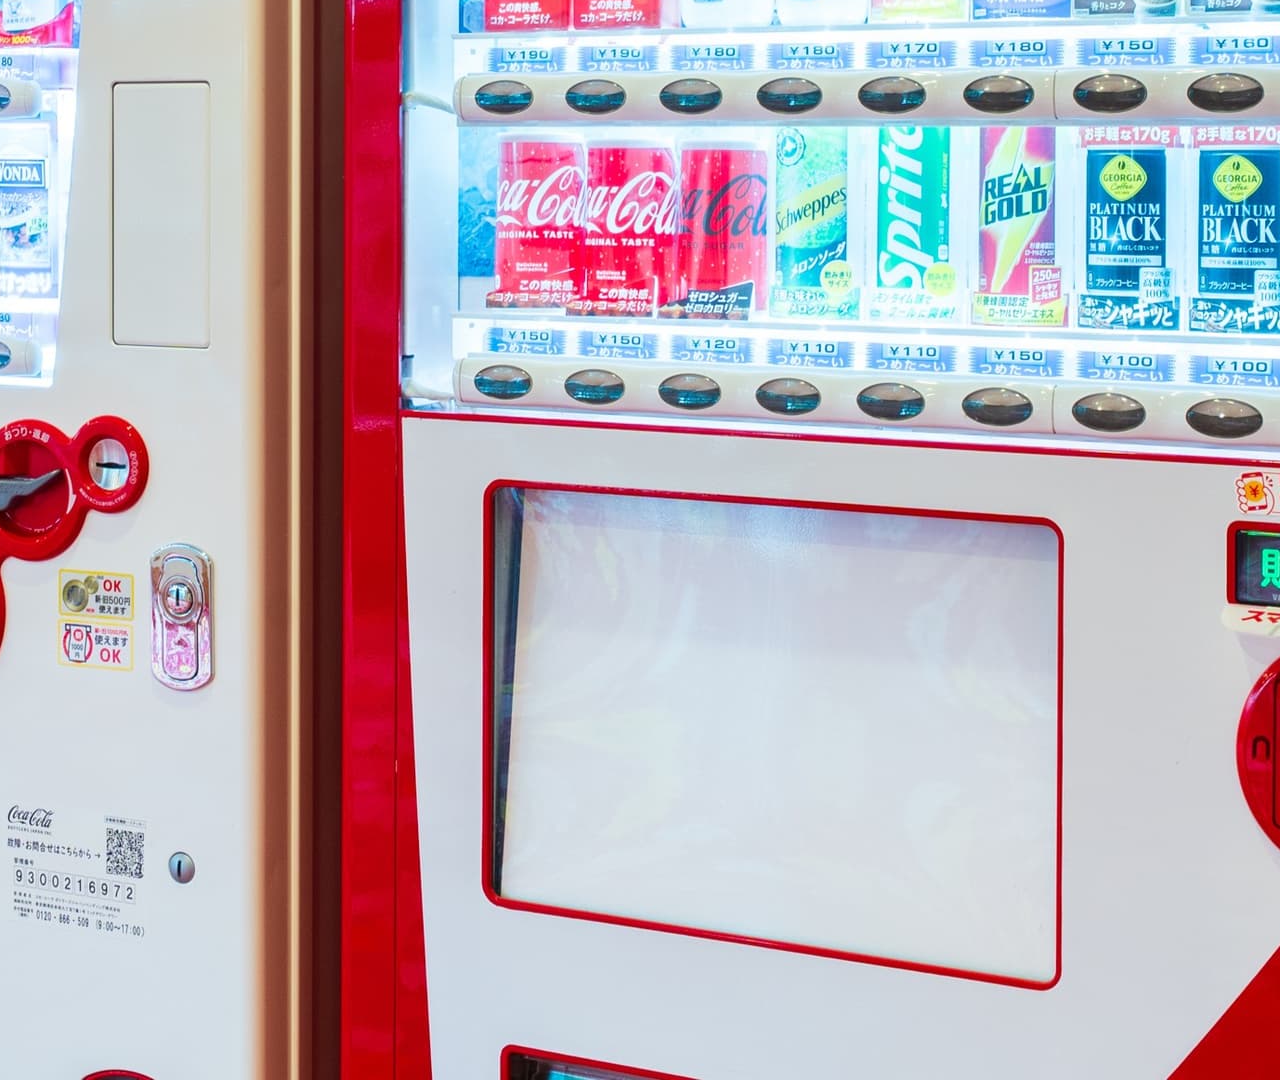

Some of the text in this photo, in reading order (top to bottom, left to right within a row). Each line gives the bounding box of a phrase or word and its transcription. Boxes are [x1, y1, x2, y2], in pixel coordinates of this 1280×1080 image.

[1215, 37, 1269, 50] ¥160
[984, 163, 1048, 202] REAL
[1103, 174, 1142, 182] GEORGIA
[1216, 175, 1257, 183] GEORGIA
[776, 187, 847, 235] Schweppes
[984, 190, 1048, 226] GOLD
[1090, 203, 1160, 215] PLATINUM
[1202, 205, 1276, 217] PLATINUM
[1090, 216, 1162, 241] BLACK
[1202, 218, 1277, 243] BLACK
[622, 238, 655, 246] TASTE
[520, 280, 578, 292] この爽快感。
[688, 292, 748, 302] ゼロシュガー
[692, 339, 736, 349] ¥120
[890, 347, 937, 357] ¥110
[994, 350, 1043, 361] ¥150
[103, 579, 121, 592] OK
[100, 648, 121, 664] OK
[7, 804, 54, 828] Coca-Cola
